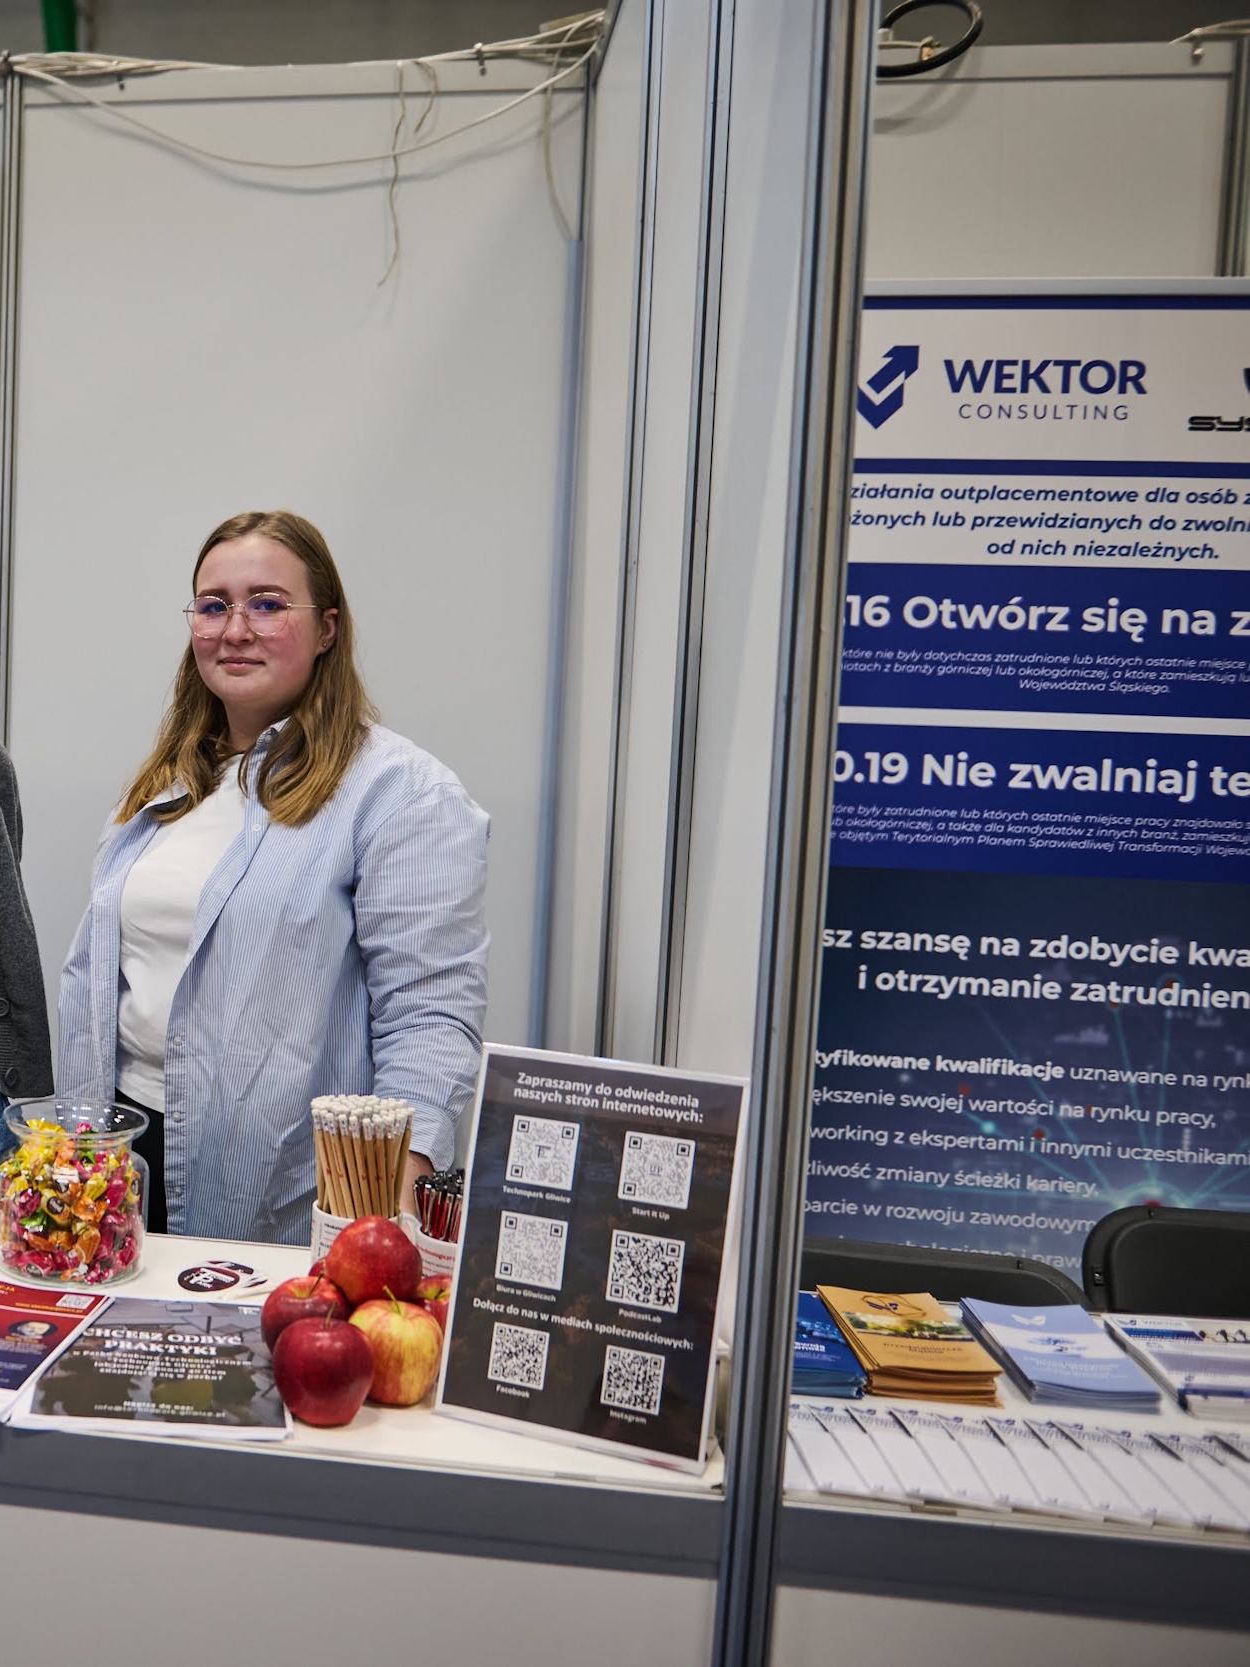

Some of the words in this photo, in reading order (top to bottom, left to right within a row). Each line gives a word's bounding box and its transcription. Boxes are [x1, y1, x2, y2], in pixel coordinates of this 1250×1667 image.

[944, 359, 1147, 394] WEKTOR
[958, 404, 1129, 420] CONSULTING
[940, 485, 1139, 504] outplacementowe
[1145, 487, 1180, 503] dla
[1185, 488, 1238, 505] osób
[849, 510, 926, 529] żonych
[932, 512, 966, 527] lub
[971, 512, 1143, 533] przewidzianych
[1149, 515, 1177, 531] do
[987, 540, 1016, 555] od
[1021, 539, 1067, 556] nich
[1073, 540, 1220, 561] niezależnych.
[903, 596, 1070, 631] Otwórz
[1081, 597, 1148, 642] się
[1161, 609, 1216, 635] na
[875, 649, 895, 659] nie
[897, 649, 922, 663] były
[924, 650, 992, 663] dotychczas
[994, 653, 1070, 665] zatrudnione
[1073, 654, 1093, 665] lub
[1096, 656, 1143, 669] których
[1145, 658, 1197, 669] ostatnie
[1199, 659, 1246, 672] miejsce
[893, 662, 935, 676] branży
[937, 665, 993, 678] górniczej
[996, 665, 1016, 676] lub
[1018, 666, 1110, 681] okołogórniczej,
[1113, 671, 1122, 679] a
[1125, 669, 1157, 681] które
[1159, 672, 1237, 685] zamieszkują
[1019, 679, 1106, 693] Województwa
[1108, 680, 1171, 695] Śląskiego.
[922, 752, 997, 788] Nie
[1008, 758, 1198, 803] zwalniaj
[857, 804, 882, 817] były
[884, 806, 957, 818] zatrudnione
[961, 808, 980, 819] lub
[983, 808, 1028, 822] których
[1031, 812, 1082, 823] ostatnie
[1084, 813, 1132, 826] miejsce
[1134, 816, 1170, 828] pracy
[1172, 817, 1243, 830] znajdowało
[839, 830, 889, 843] objętym
[892, 831, 974, 846] Terytorialnym
[977, 834, 1026, 847] Planem
[1028, 836, 1114, 853] Sprawiedliwej
[1118, 840, 1202, 856] Transformacji
[846, 818, 934, 831] okołogórniczej,
[937, 823, 945, 831] a
[948, 820, 981, 832] także
[984, 821, 1004, 833] dla
[1007, 822, 1084, 836] kandydatów
[1086, 829, 1093, 837] z
[1096, 826, 1138, 840] innych
[1141, 828, 1179, 841] branż,
[1181, 832, 1250, 845] zamieszkuj
[860, 930, 971, 960] szansę
[980, 936, 1020, 957] na
[1029, 934, 1180, 967] zdobycie
[858, 964, 868, 990] i
[875, 969, 1062, 1000] otrzymanie
[936, 1055, 1065, 1079] kwalifikacje
[1069, 1066, 1177, 1086] uznawane
[1182, 1073, 1207, 1088] na
[517, 1072, 593, 1095] Zapraszamy
[595, 1082, 612, 1097] do
[615, 1086, 700, 1108] odwiedzenia
[513, 1087, 562, 1104] naszych
[565, 1094, 599, 1109] stron
[602, 1098, 704, 1124] internetowych:
[900, 1093, 964, 1115] swojej
[968, 1098, 1054, 1116] wartości
[1059, 1105, 1085, 1119] na
[1090, 1104, 1150, 1123] rynku
[1156, 1110, 1216, 1129] pracy,
[893, 1131, 904, 1144] z
[909, 1130, 1024, 1152] ekspertami
[1030, 1137, 1036, 1153] i
[1041, 1138, 1112, 1159] innymi
[503, 1185, 544, 1199] Technopark
[545, 1192, 571, 1203] Gliwice
[876, 1167, 950, 1187] zmiany
[954, 1170, 1020, 1190] ścieżki
[1026, 1175, 1099, 1196] kariery,
[632, 1207, 650, 1217] Start
[659, 1211, 670, 1221] Up
[863, 1204, 881, 1216] w
[886, 1206, 964, 1225] rozwoju
[473, 1297, 505, 1313] Dołącz
[506, 1303, 519, 1315] do
[521, 1308, 538, 1319] nas
[539, 1312, 551, 1321] w
[551, 1313, 593, 1330] mediach
[594, 1322, 694, 1350] społecznościowych:
[104, 1340, 217, 1356] PRAKTYKI
[167, 1333, 242, 1345] ODBYĆ
[496, 1385, 530, 1398] Facebook
[609, 1410, 647, 1425] Instagram
